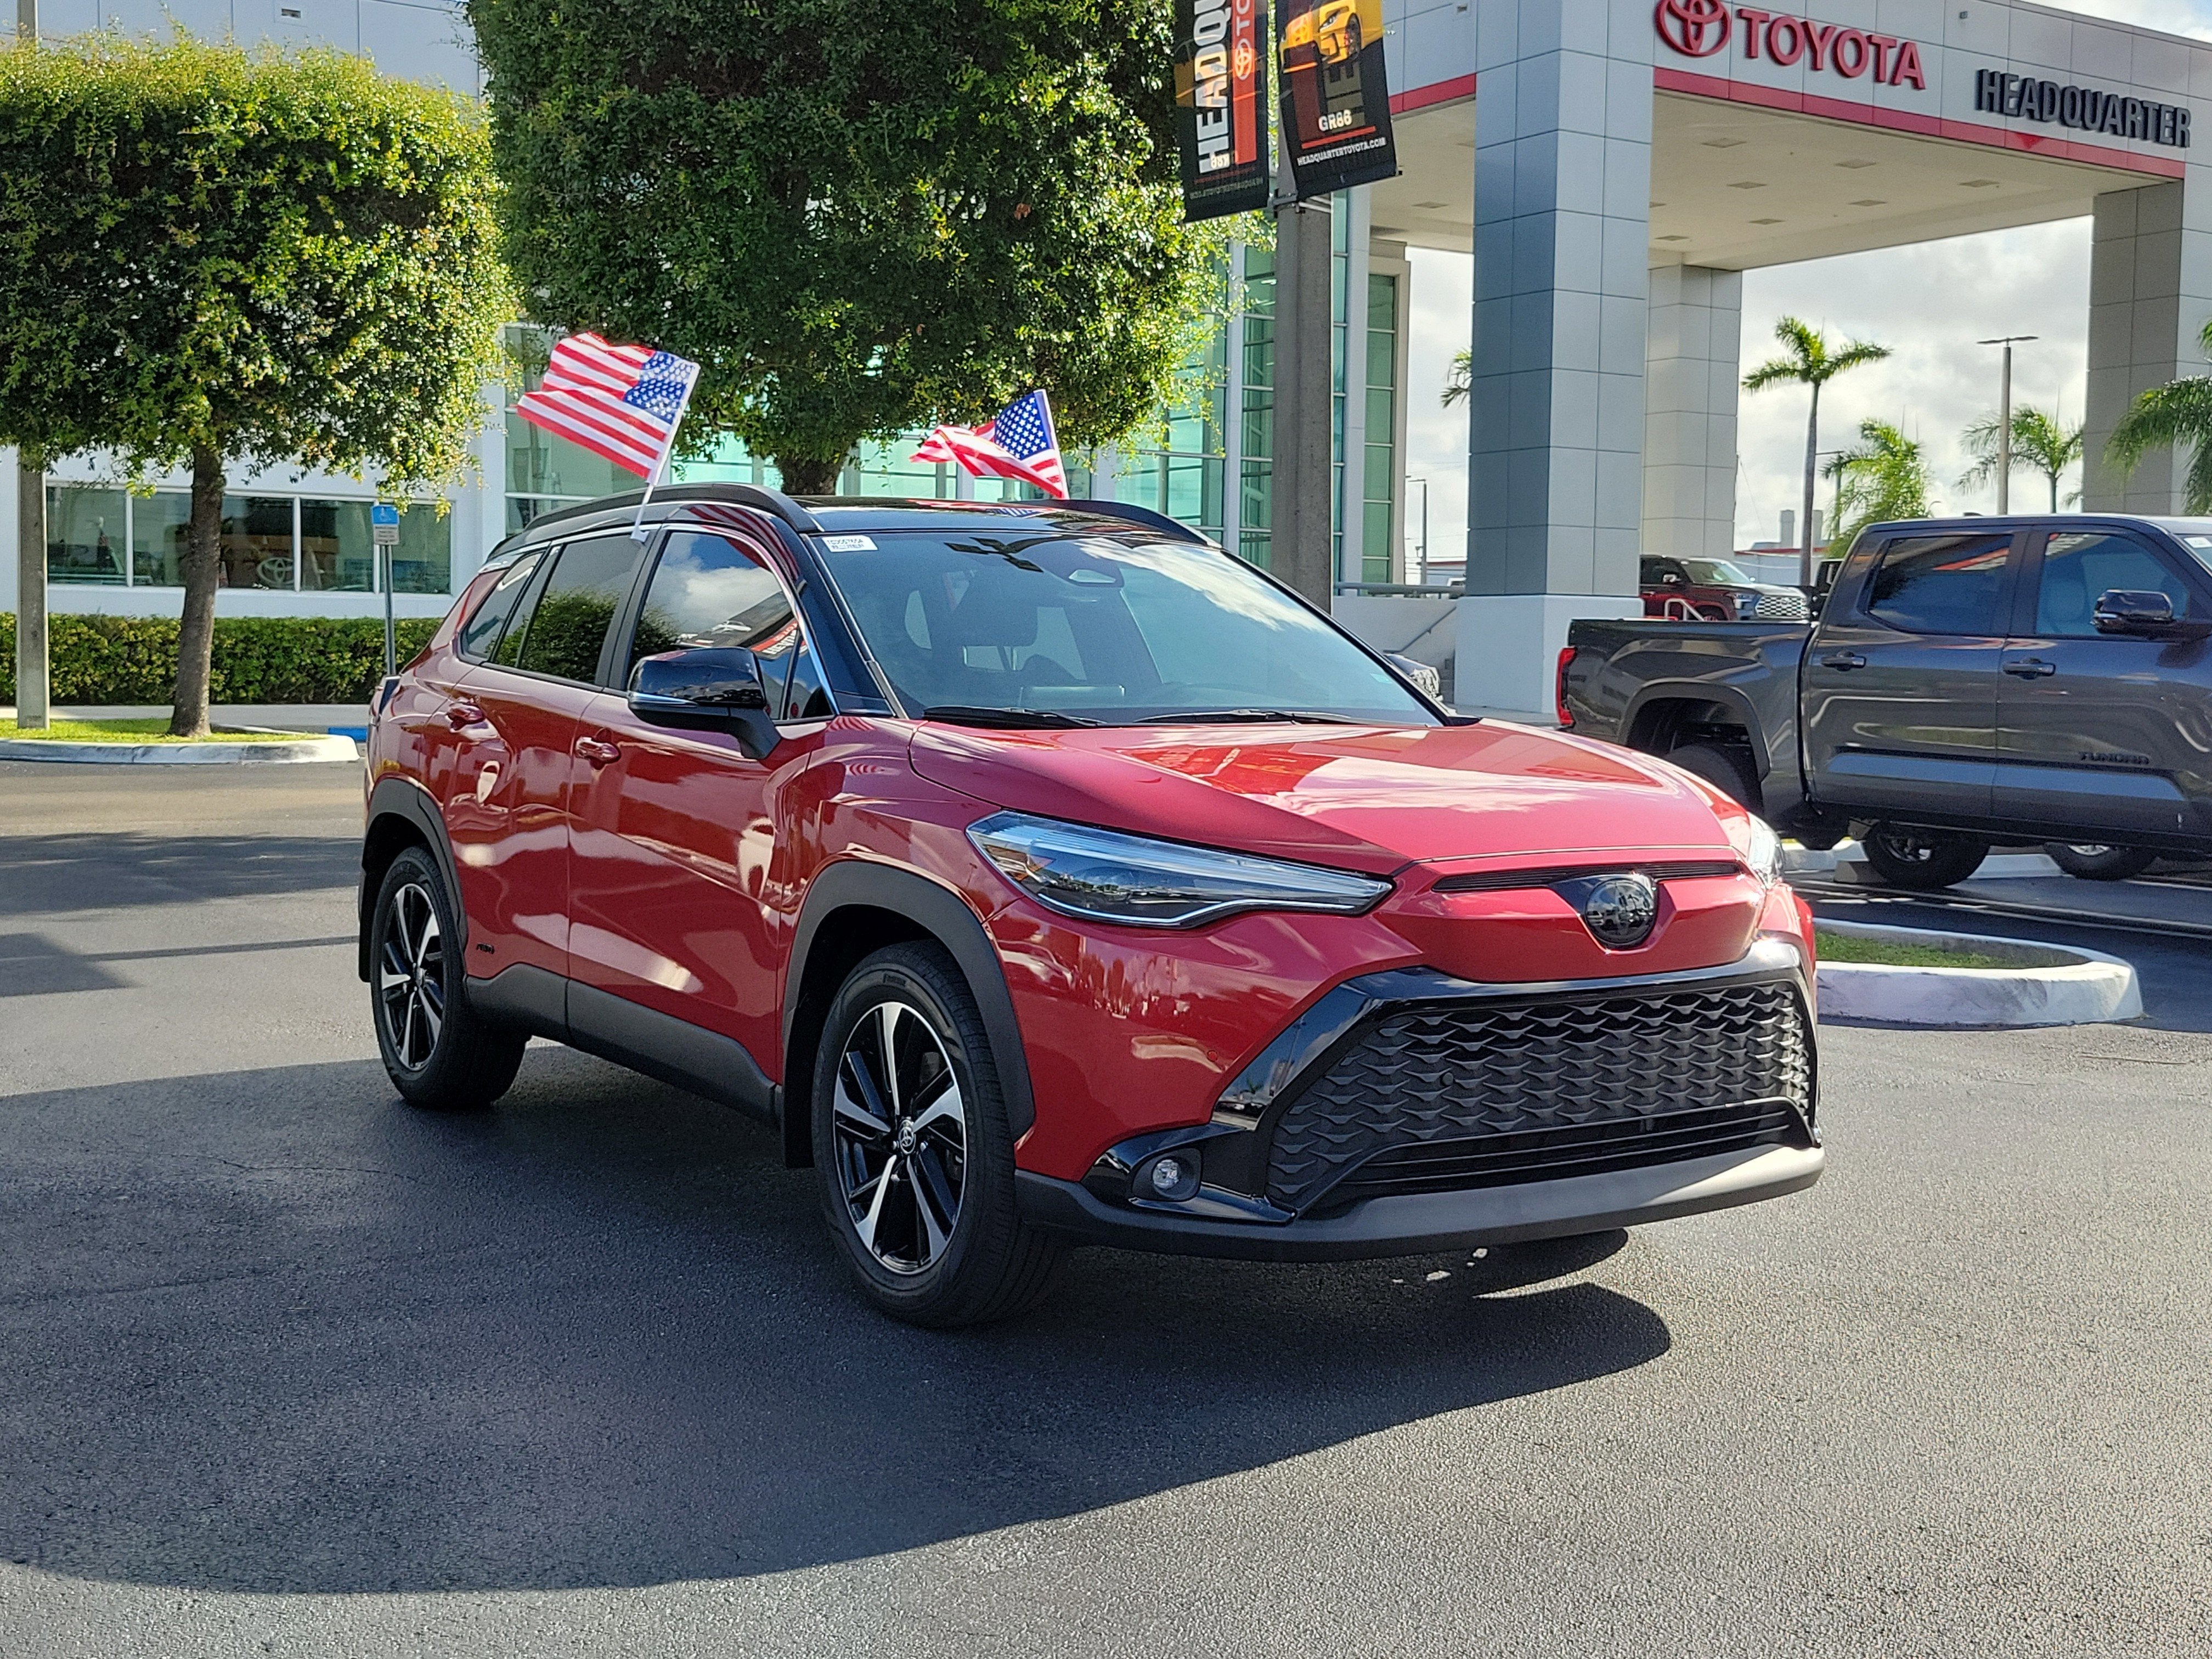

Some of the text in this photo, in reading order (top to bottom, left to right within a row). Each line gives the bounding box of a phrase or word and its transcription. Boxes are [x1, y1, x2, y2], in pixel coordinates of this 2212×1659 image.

[1736, 8, 1926, 90] TOYOTA
[1318, 109, 1353, 132] GR86
[1975, 69, 2191, 148] HEADQUARTER
[1296, 137, 1387, 166] HEADQUARTERTOYOTA.COM
